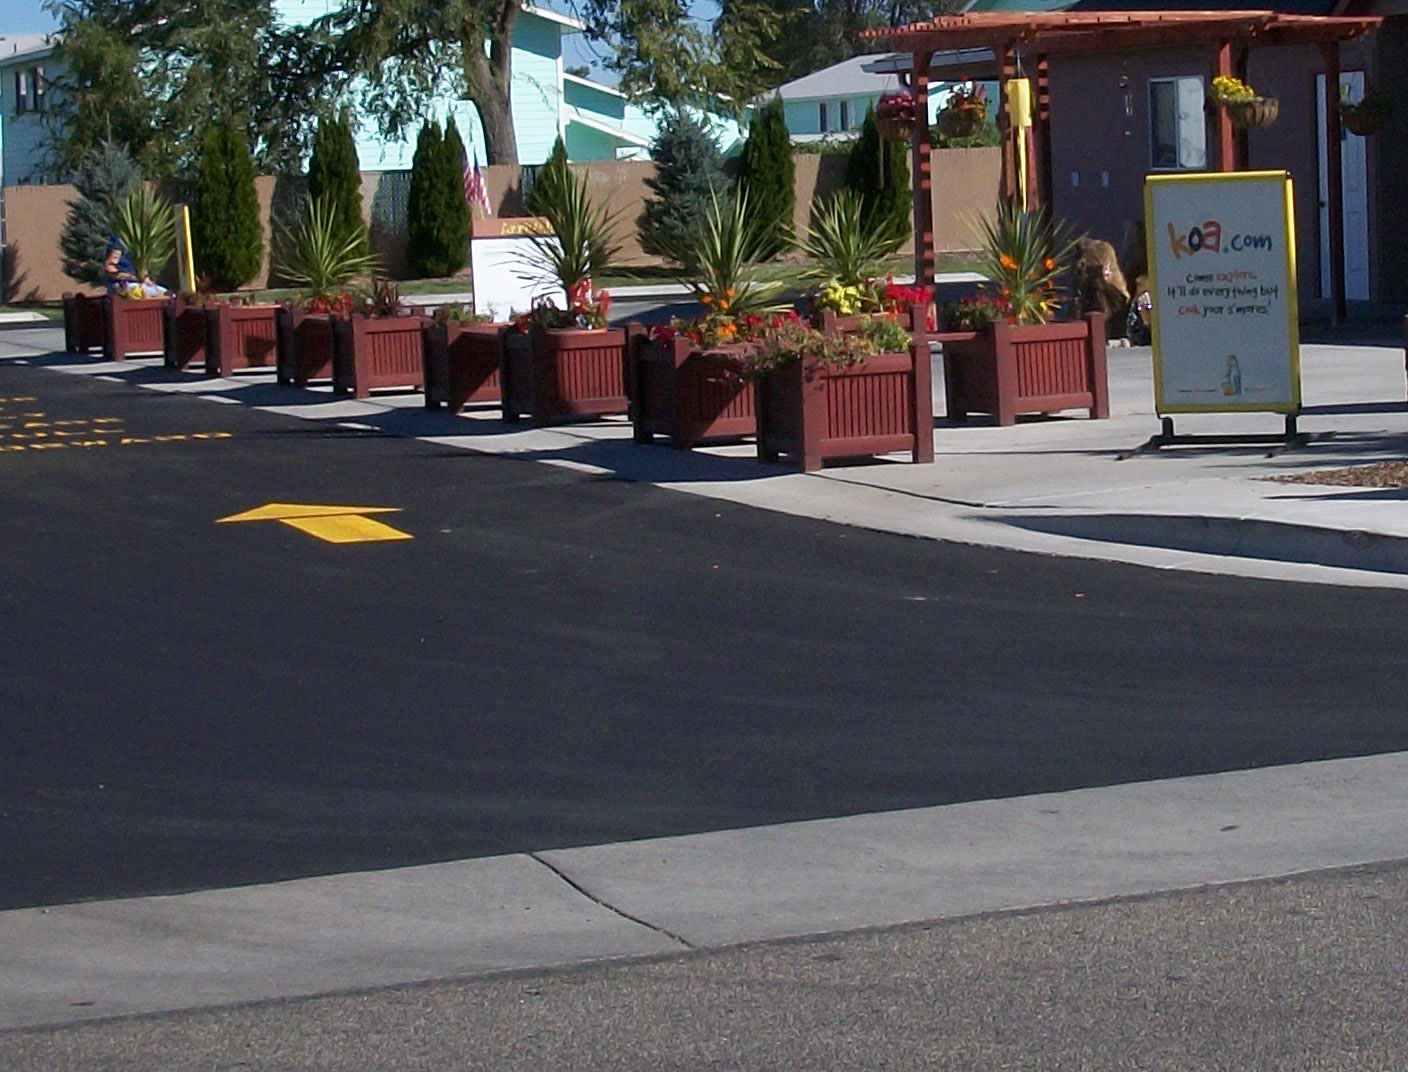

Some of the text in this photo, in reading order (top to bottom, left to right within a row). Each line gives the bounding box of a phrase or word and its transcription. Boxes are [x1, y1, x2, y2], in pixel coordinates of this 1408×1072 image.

[1167, 220, 1273, 260] koa.com
[1188, 287, 1200, 297] do
[1260, 285, 1279, 299] but
[1201, 305, 1225, 318] your
